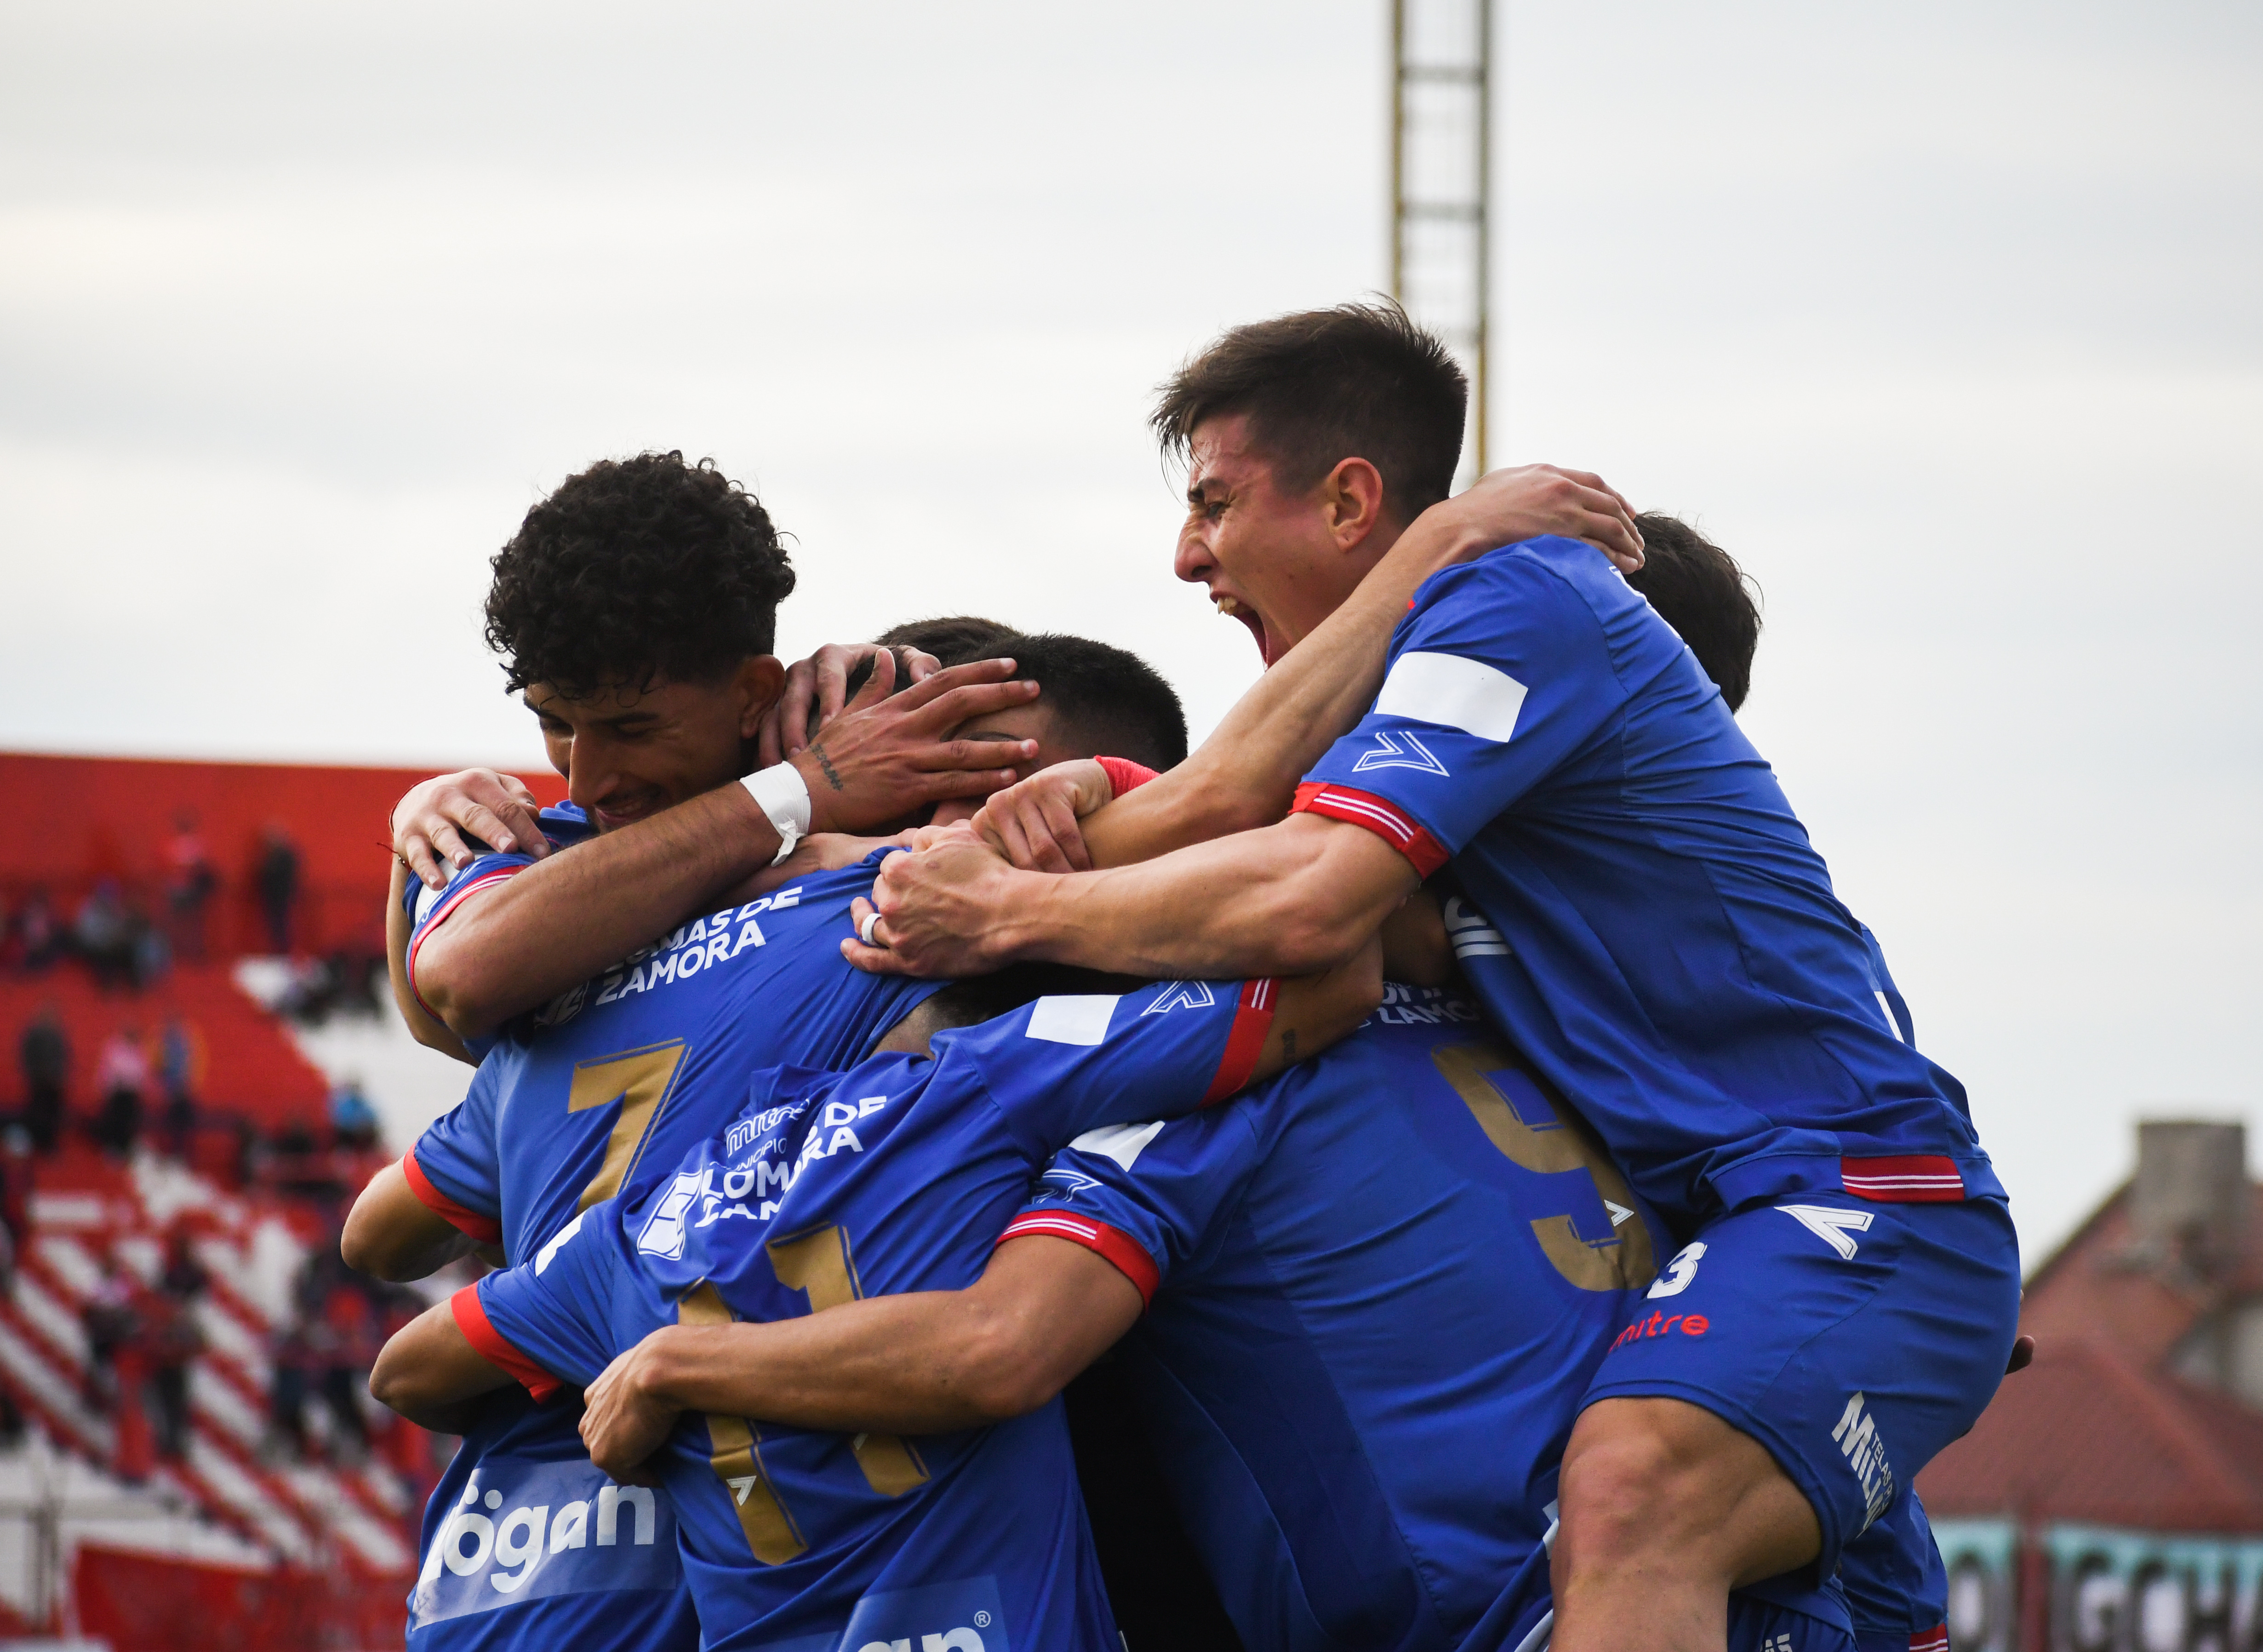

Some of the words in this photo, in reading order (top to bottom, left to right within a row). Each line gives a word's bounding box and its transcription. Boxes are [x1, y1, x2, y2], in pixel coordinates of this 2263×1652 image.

[735, 886, 802, 923] DE
[595, 920, 766, 1006] ZAMORA
[567, 1036, 692, 1217] 7
[824, 1096, 887, 1128] DE
[1430, 1041, 1659, 1292] 9
[1871, 1431, 1892, 1487] TELAS
